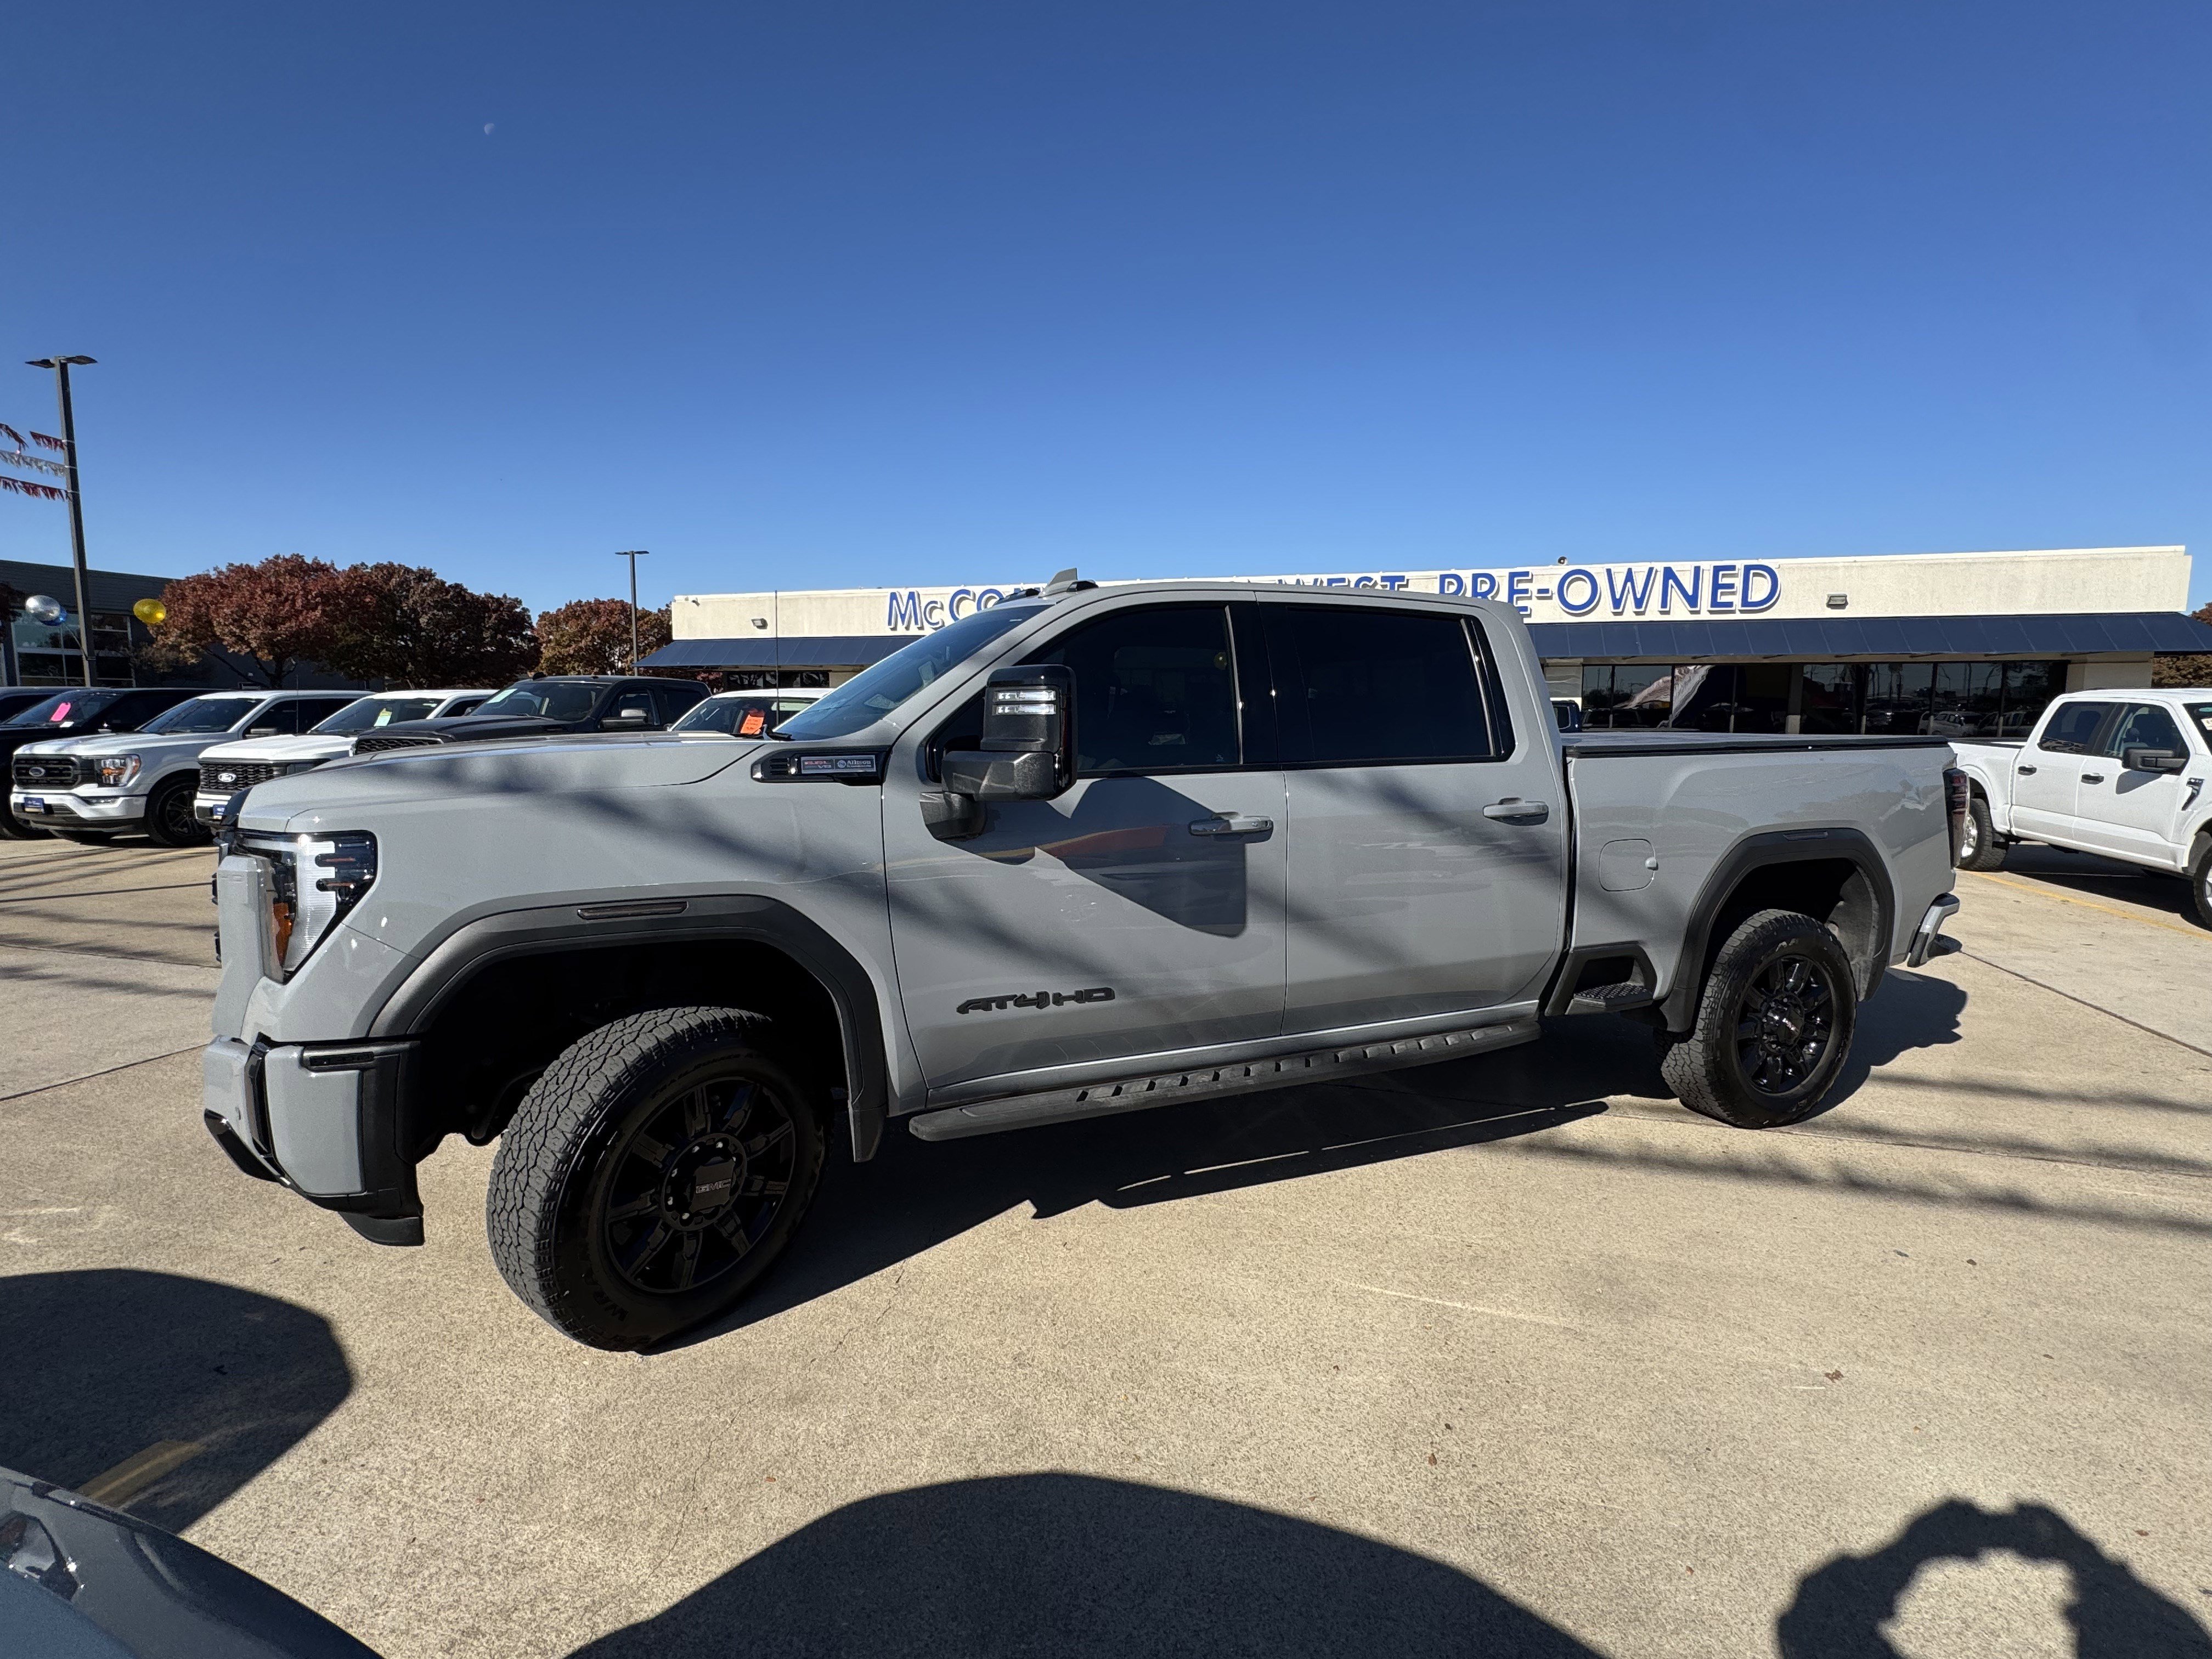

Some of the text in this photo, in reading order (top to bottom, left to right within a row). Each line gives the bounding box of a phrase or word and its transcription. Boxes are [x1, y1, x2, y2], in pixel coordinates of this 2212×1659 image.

[887, 564, 1779, 627] McCO PRE-OWNED
[696, 1178, 731, 1194] GMC
